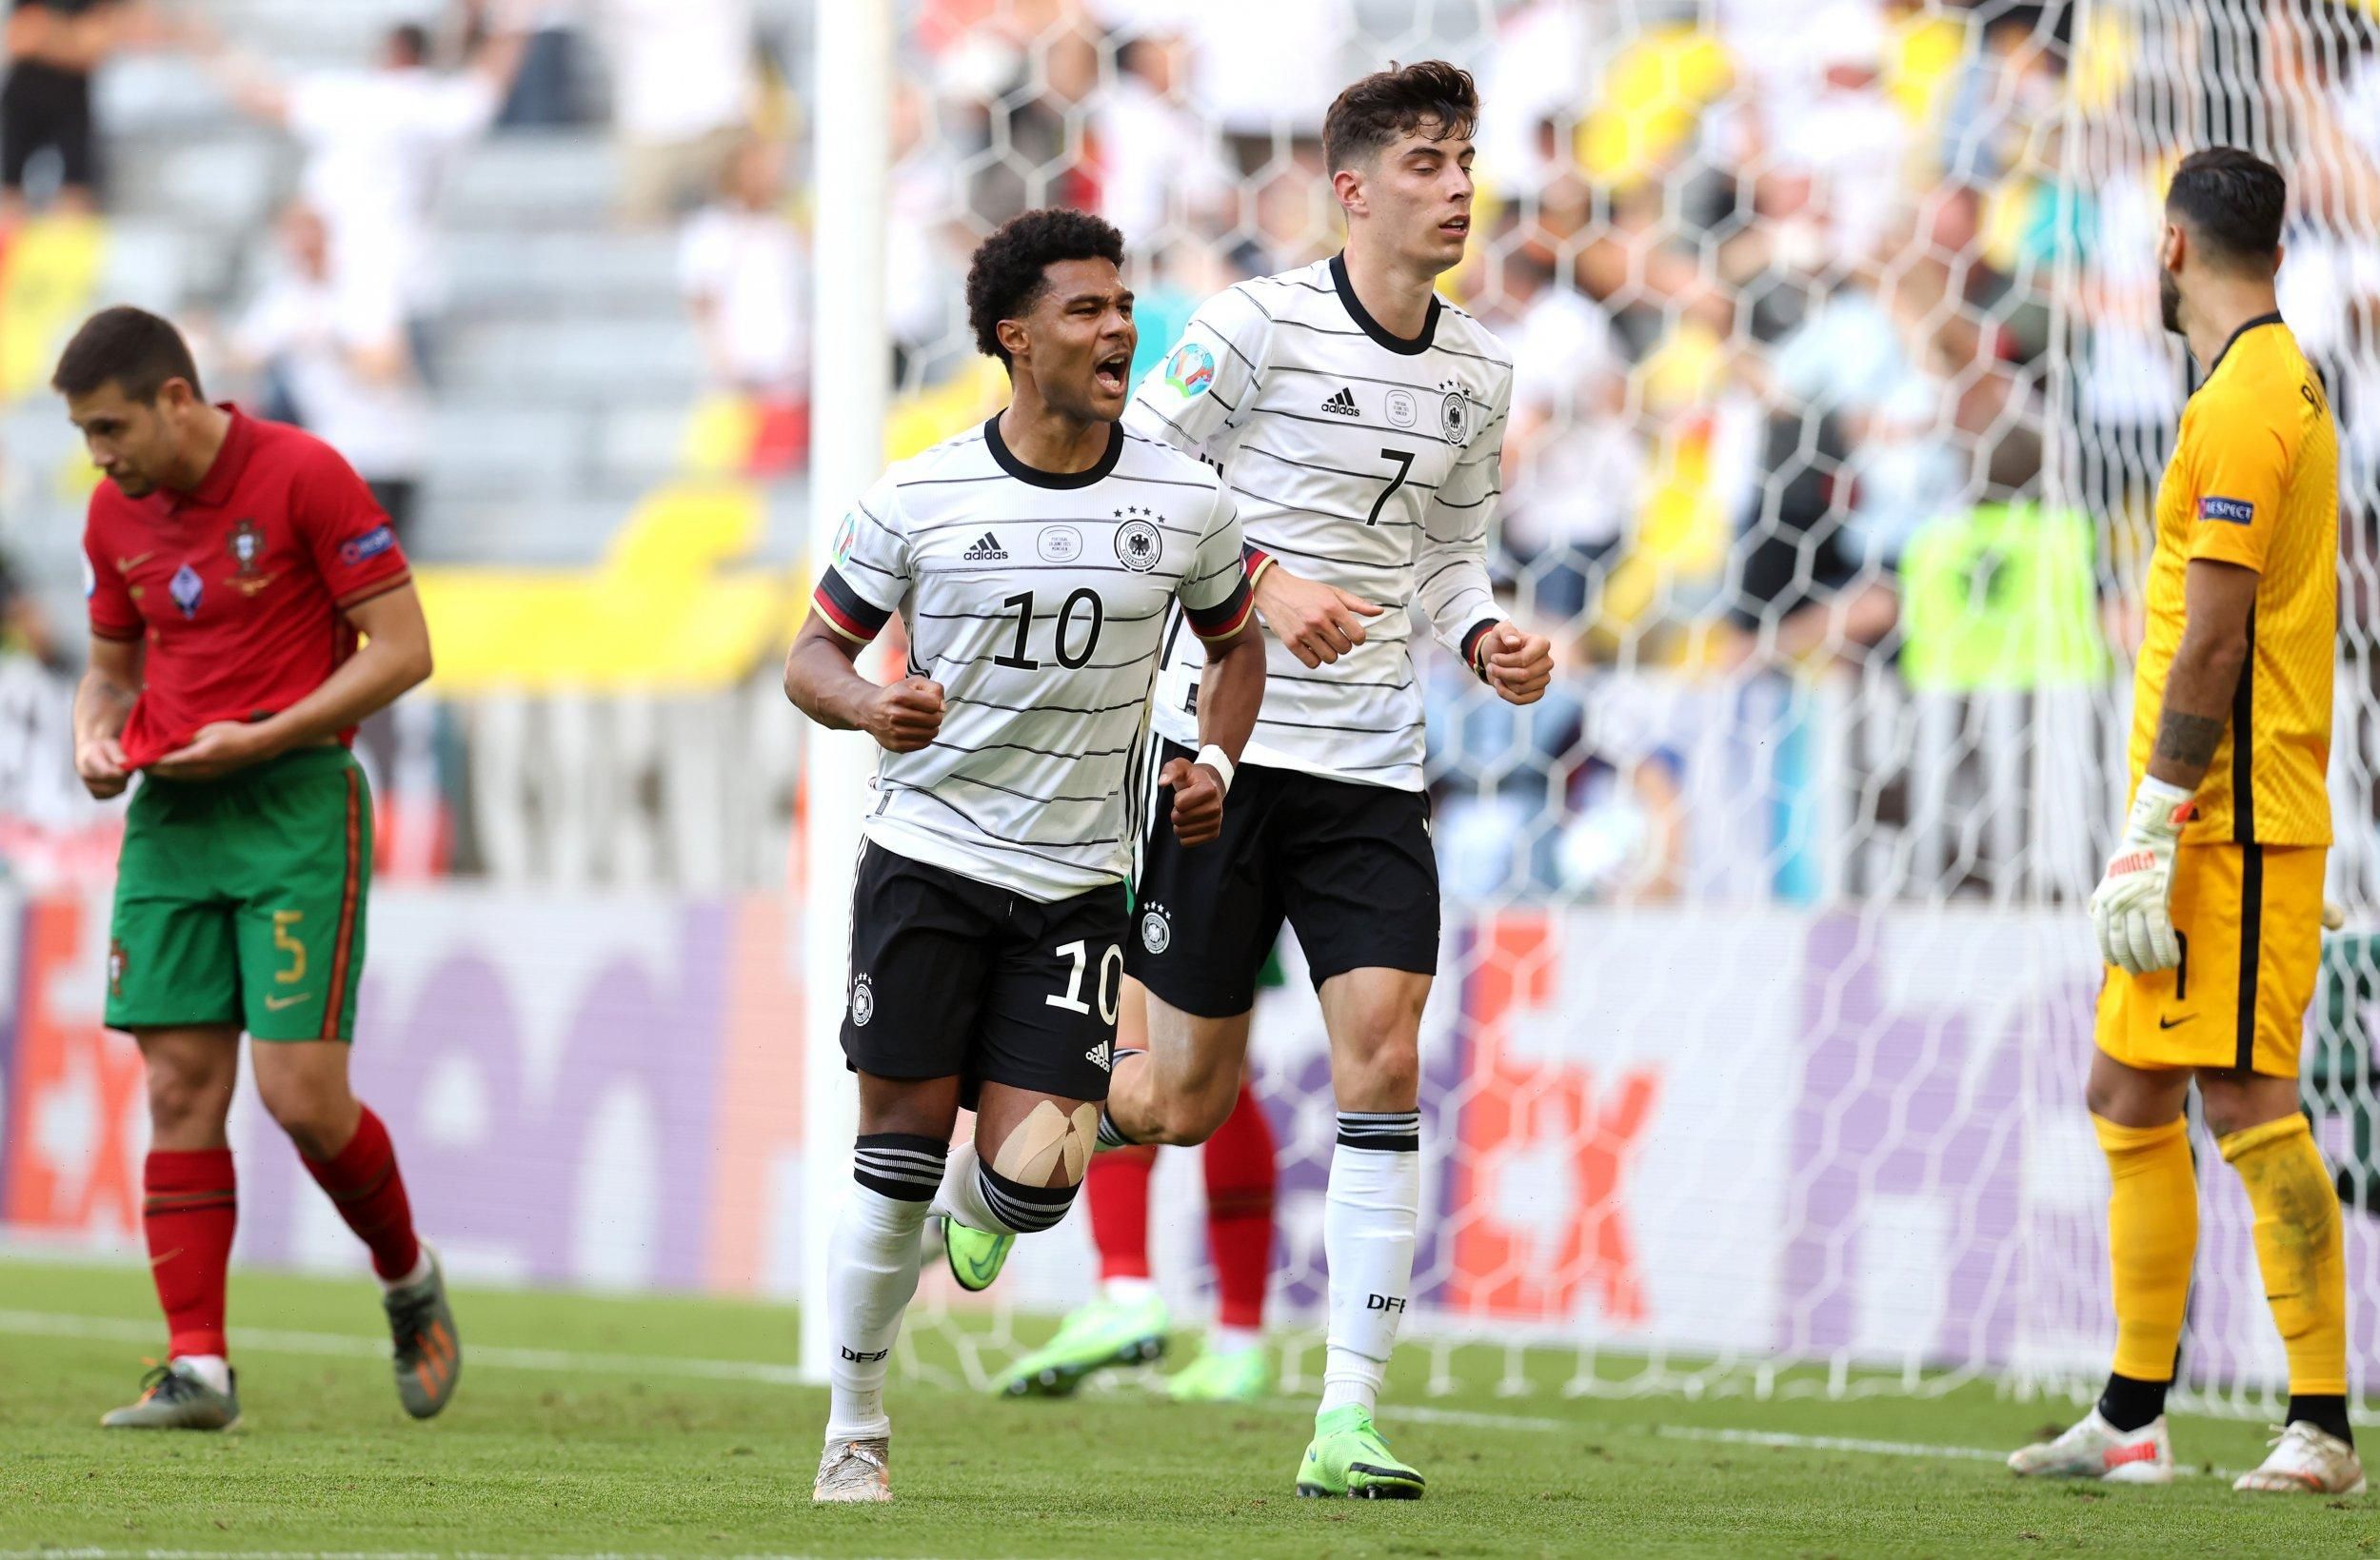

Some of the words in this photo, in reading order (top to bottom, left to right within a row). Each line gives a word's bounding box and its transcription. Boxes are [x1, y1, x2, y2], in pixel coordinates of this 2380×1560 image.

[1320, 403, 1360, 417] adidas
[1366, 447, 1417, 526] 7
[963, 549, 1009, 561] adidas
[993, 587, 1103, 671] 10
[274, 910, 306, 984] 5
[1045, 939, 1123, 1026] 10
[1085, 1051, 1111, 1073] adidas
[842, 1345, 888, 1363] DFB
